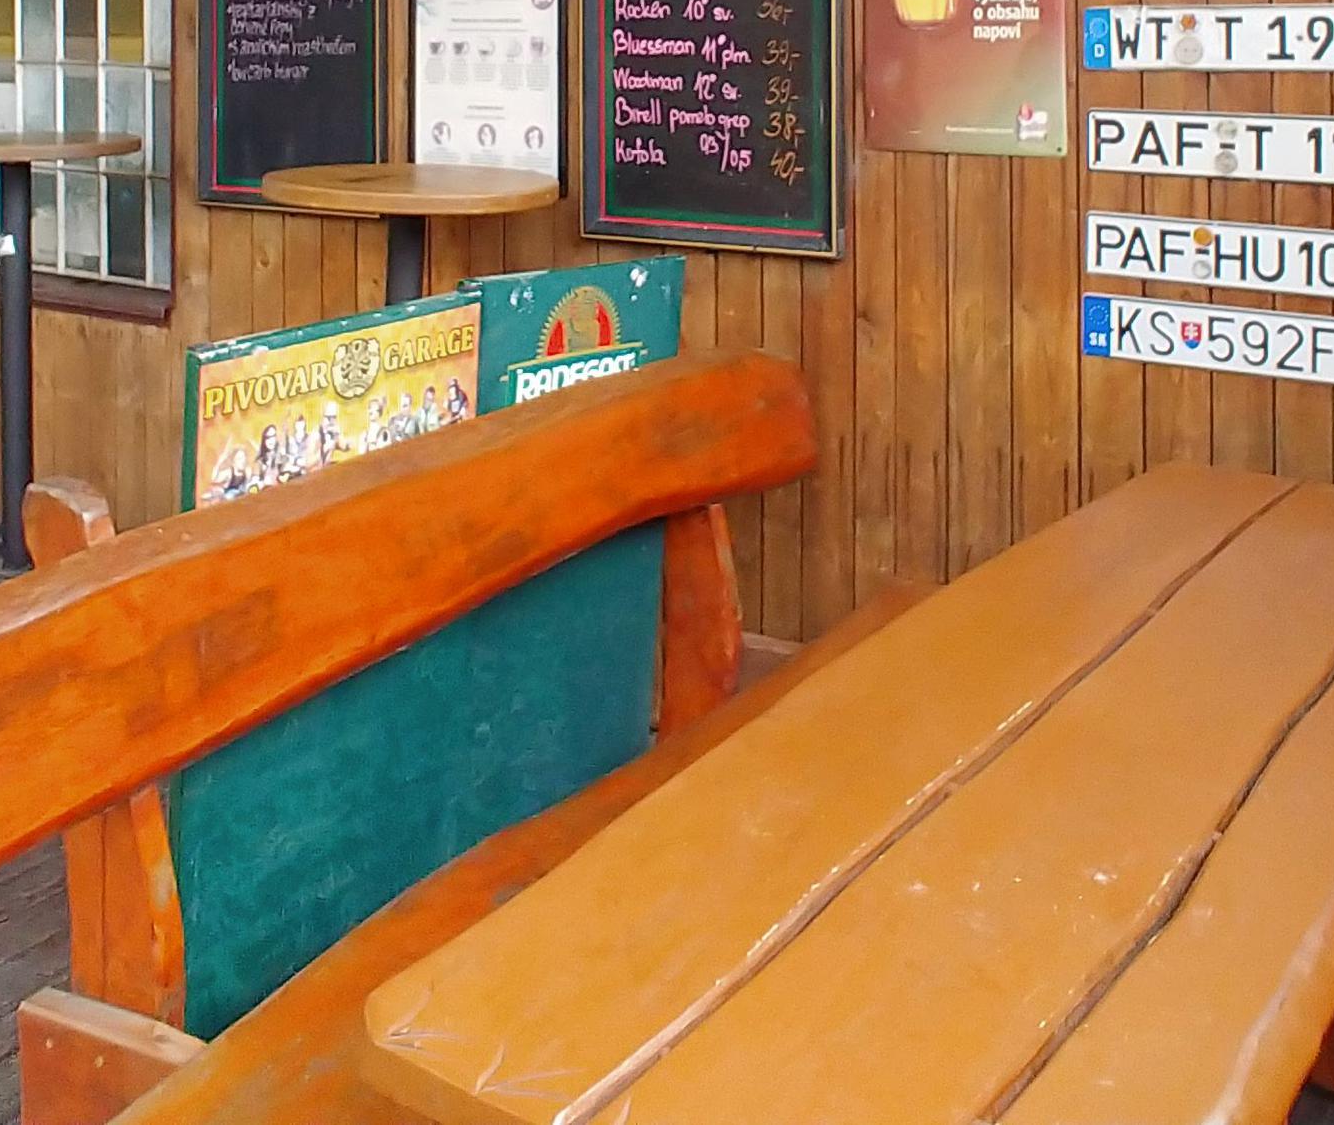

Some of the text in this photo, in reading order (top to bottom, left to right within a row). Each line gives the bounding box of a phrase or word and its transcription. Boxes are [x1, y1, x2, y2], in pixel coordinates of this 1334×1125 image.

[973, 3, 1040, 20] o obsahu
[973, 21, 1021, 43] napoví
[1115, 16, 1174, 60] WT
[1215, 16, 1243, 60] T
[1094, 43, 1105, 59] D
[614, 67, 683, 91] Woodman
[616, 137, 667, 165] Kofola
[1089, 332, 1107, 347] SK
[1116, 305, 1175, 356] KS
[203, 324, 474, 421] PIVOVAR GARAGE
